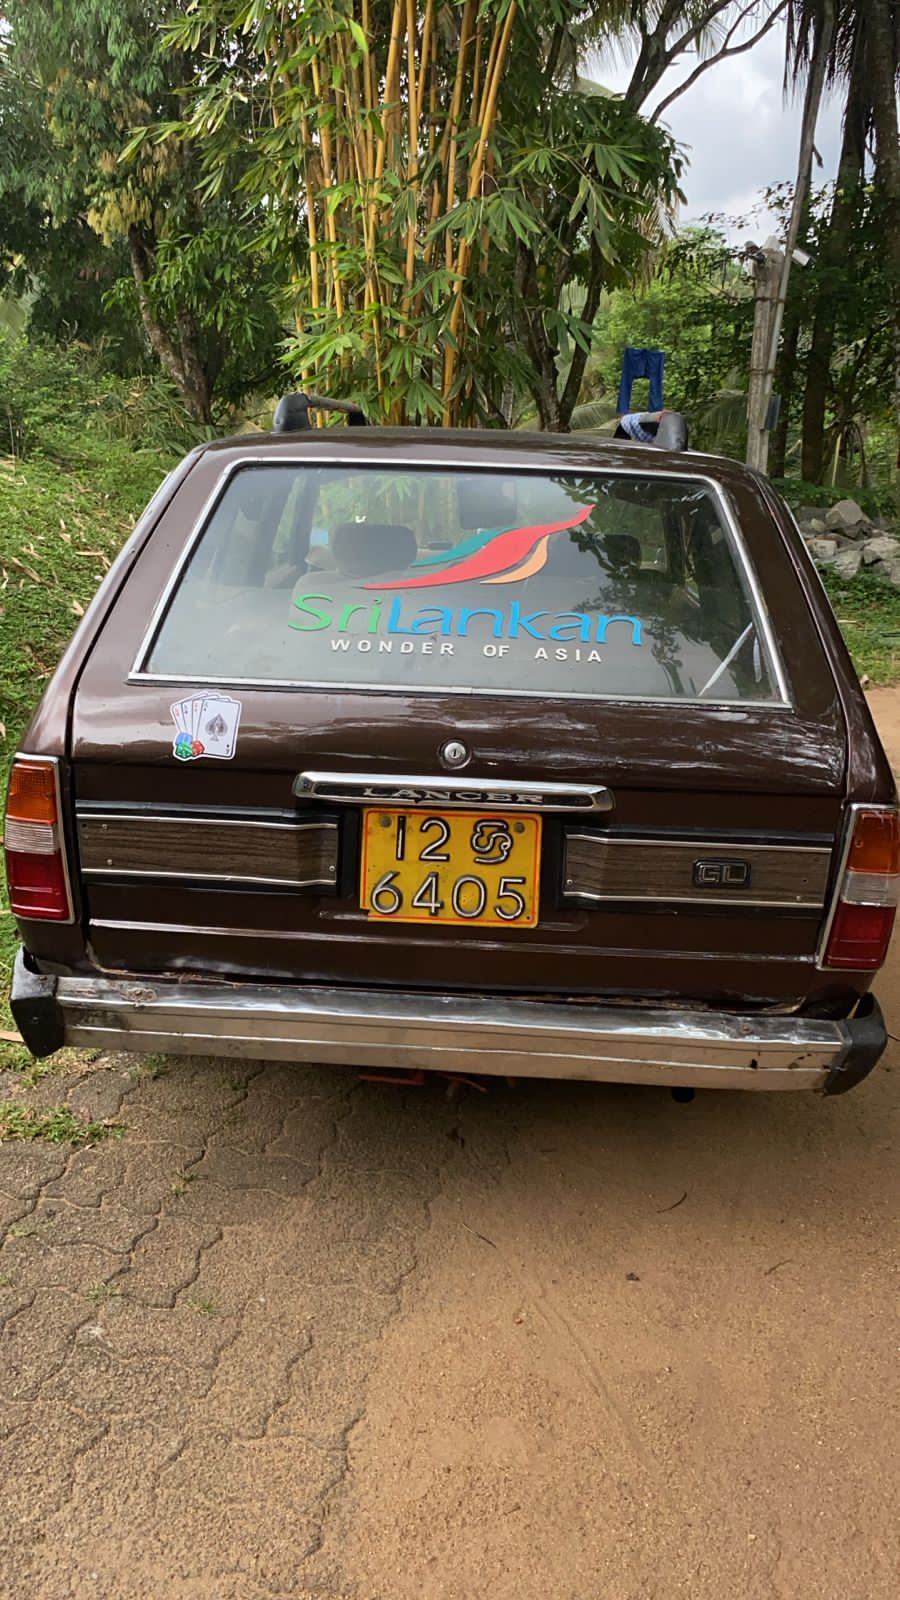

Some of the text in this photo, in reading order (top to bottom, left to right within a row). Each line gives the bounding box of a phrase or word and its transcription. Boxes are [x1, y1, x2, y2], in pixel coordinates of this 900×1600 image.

[287, 592, 643, 646] SriLankan
[331, 638, 602, 662] WONDER OF ASIA
[363, 788, 544, 803] LANCER
[395, 816, 450, 862] 12
[698, 864, 745, 883] GL
[371, 871, 527, 920] 6405
